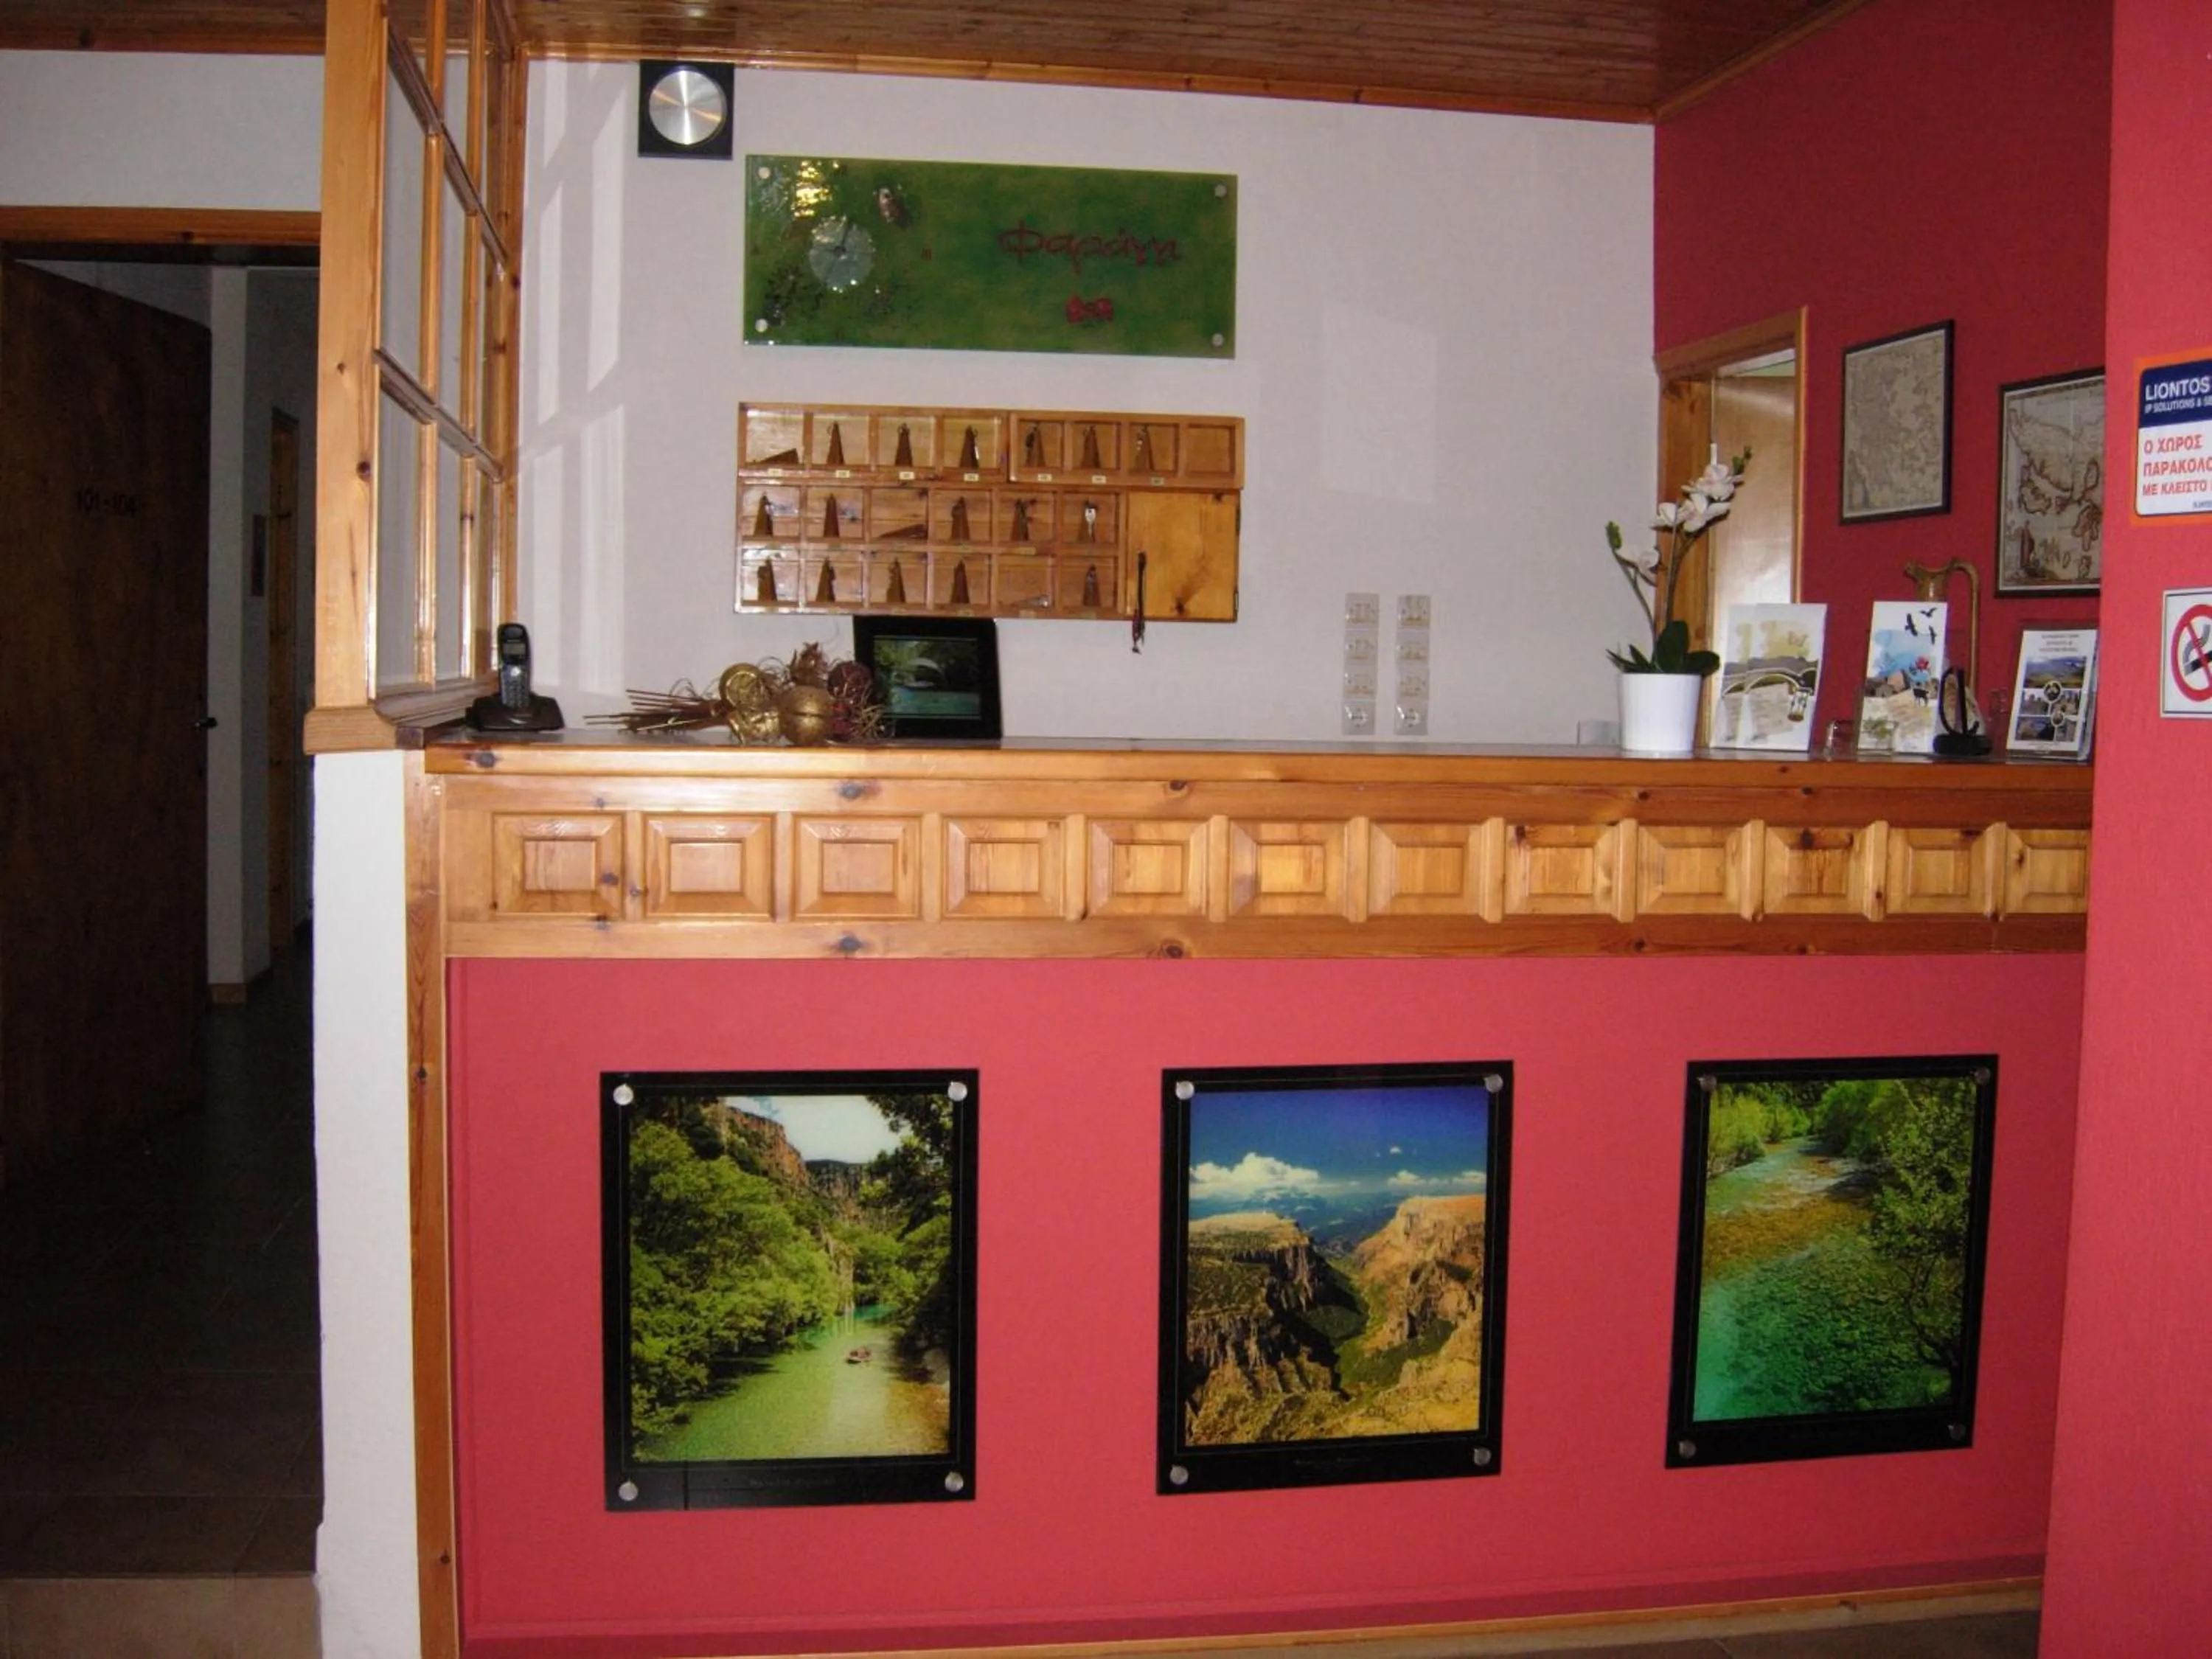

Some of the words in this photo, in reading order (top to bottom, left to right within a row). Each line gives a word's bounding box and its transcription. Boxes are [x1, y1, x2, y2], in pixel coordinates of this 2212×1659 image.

[2145, 376, 2211, 400] LIONTOS
[2153, 397, 2194, 413] SOLUTIONS
[2143, 439, 2153, 454] Ο
[2157, 434, 2202, 453] ΧΩΡΟΣ
[2142, 483, 2158, 496] ΜΕ
[2160, 479, 2207, 495] ΚΛΕΙΣΤΟ
